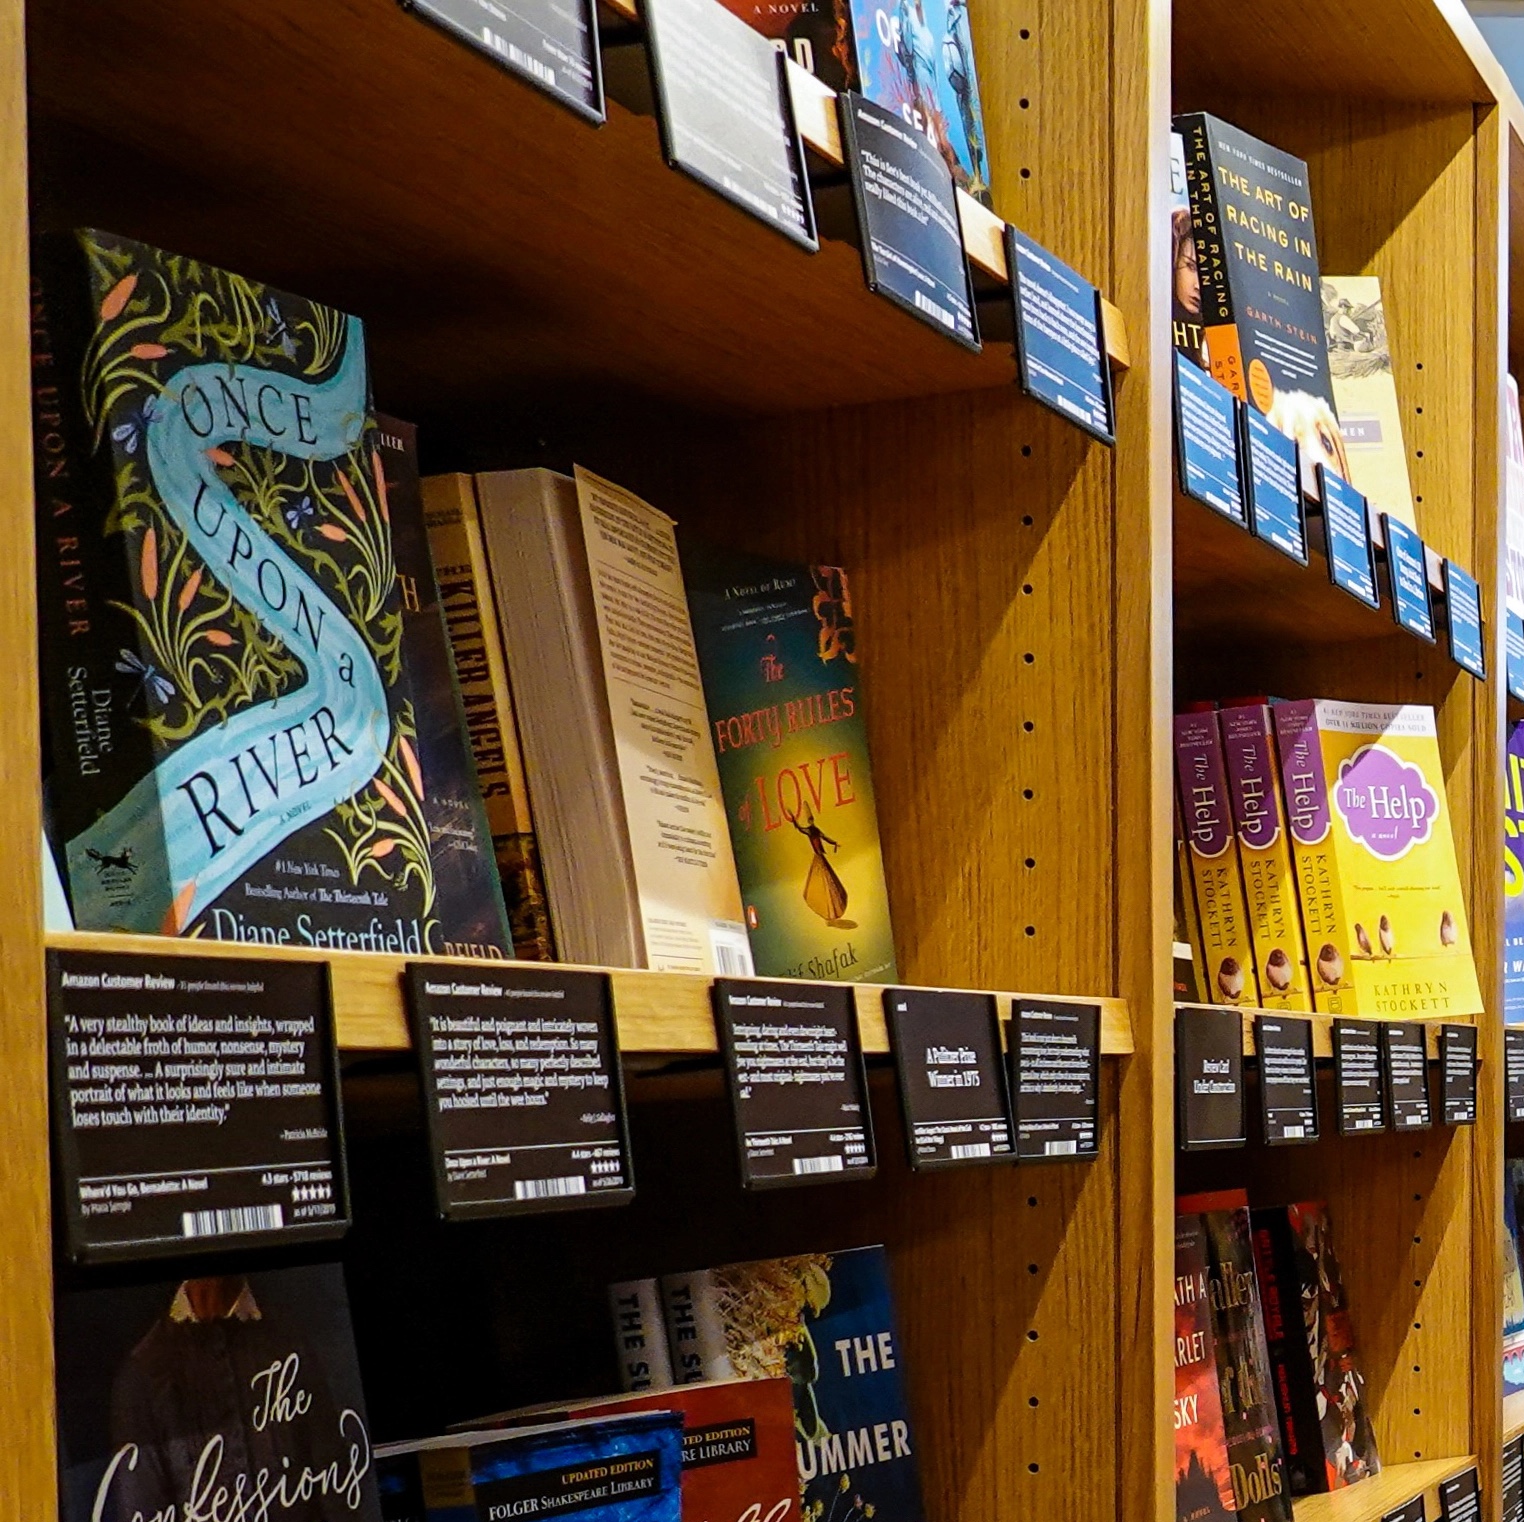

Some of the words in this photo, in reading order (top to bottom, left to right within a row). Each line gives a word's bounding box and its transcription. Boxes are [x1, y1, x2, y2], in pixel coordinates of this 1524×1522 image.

[1218, 165, 1251, 198] THE
[1253, 180, 1283, 210] ART
[1287, 198, 1310, 223] OF
[1226, 204, 1291, 249] RACING
[1294, 233, 1313, 258] IN
[1233, 241, 1270, 274] THE
[1273, 258, 1313, 293] RAIN
[1245, 304, 1282, 333] GARTH
[1283, 315, 1318, 346] STEIN
[179, 374, 319, 446] ONCE
[190, 476, 327, 654] UPON
[442, 578, 488, 686] KILLER
[339, 651, 356, 689] a
[760, 652, 785, 684] The
[66, 666, 102, 777] Setterfield
[92, 688, 115, 754] Diane
[715, 709, 783, 754] FORTY
[787, 687, 856, 737] RULES
[1292, 739, 1307, 768] The
[175, 704, 355, 859] RIVER
[755, 752, 857, 833] LOVE
[1290, 769, 1316, 829] Help
[1342, 787, 1366, 811] The
[1370, 783, 1426, 829] Help
[1302, 855, 1322, 937] STOCKETT
[1317, 853, 1337, 935] KATHRYN
[213, 908, 292, 946] Diane
[296, 914, 420, 955] Setterfield
[62, 971, 100, 989] Amazon
[101, 972, 144, 989] Customer
[145, 973, 175, 989] Review
[807, 943, 859, 979] Shafak
[1373, 981, 1449, 998] KATHRYN
[1375, 997, 1450, 1012] STOCKETT
[80, 1018, 104, 1037] very
[106, 1014, 148, 1037] stealthy
[150, 1014, 175, 1032] book
[176, 1014, 187, 1032] of
[187, 1014, 213, 1032] ideas
[215, 1015, 233, 1032] and
[234, 1015, 275, 1036] insights,
[276, 1016, 314, 1036] wrapped
[834, 1331, 896, 1378] THE
[250, 1351, 312, 1432] The
[561, 1463, 608, 1485] UPDATED
[609, 1457, 654, 1478] EDITION
[1229, 1458, 1284, 1511] Dolls
[488, 1500, 539, 1522] FOLGER
[540, 1486, 608, 1512] SHAKESPEARE
[609, 1476, 654, 1499] LIBRARY
